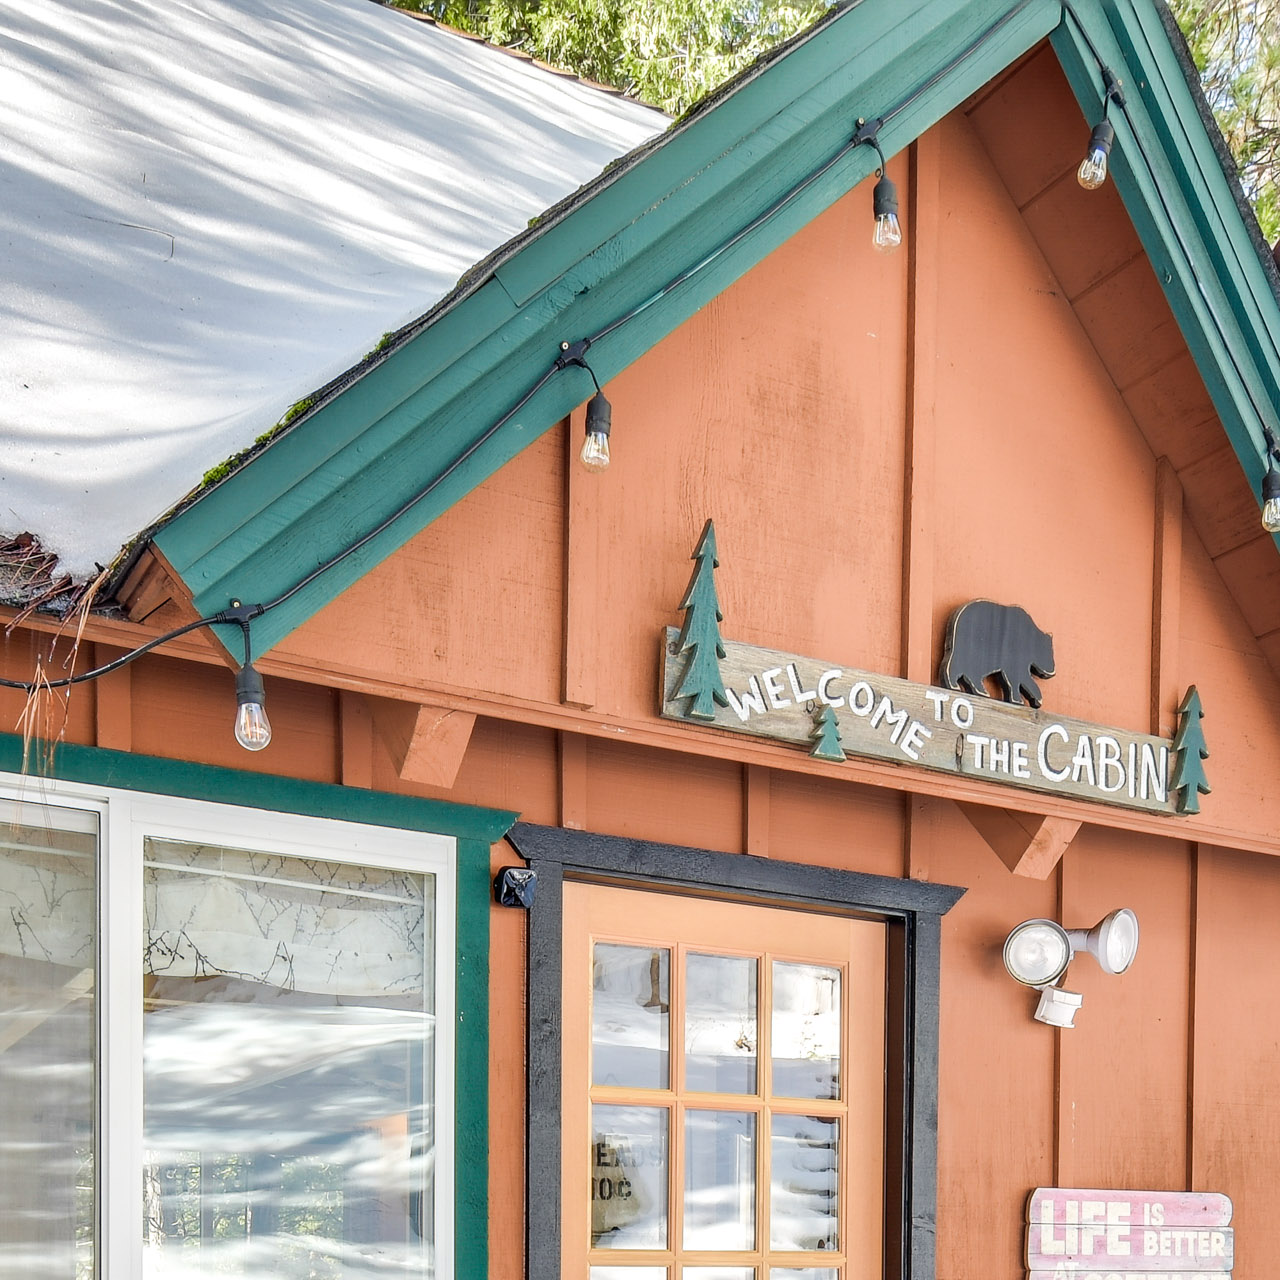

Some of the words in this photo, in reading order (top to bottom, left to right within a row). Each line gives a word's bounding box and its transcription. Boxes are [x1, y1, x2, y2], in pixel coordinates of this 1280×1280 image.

[725, 663, 932, 760] WELCOME
[925, 689, 974, 729] TO
[967, 734, 1031, 779] THE
[1037, 723, 1169, 803] CABIN
[1040, 1199, 1131, 1256] LIFE
[1143, 1202, 1165, 1226] IS
[1143, 1230, 1226, 1257] BETTER
